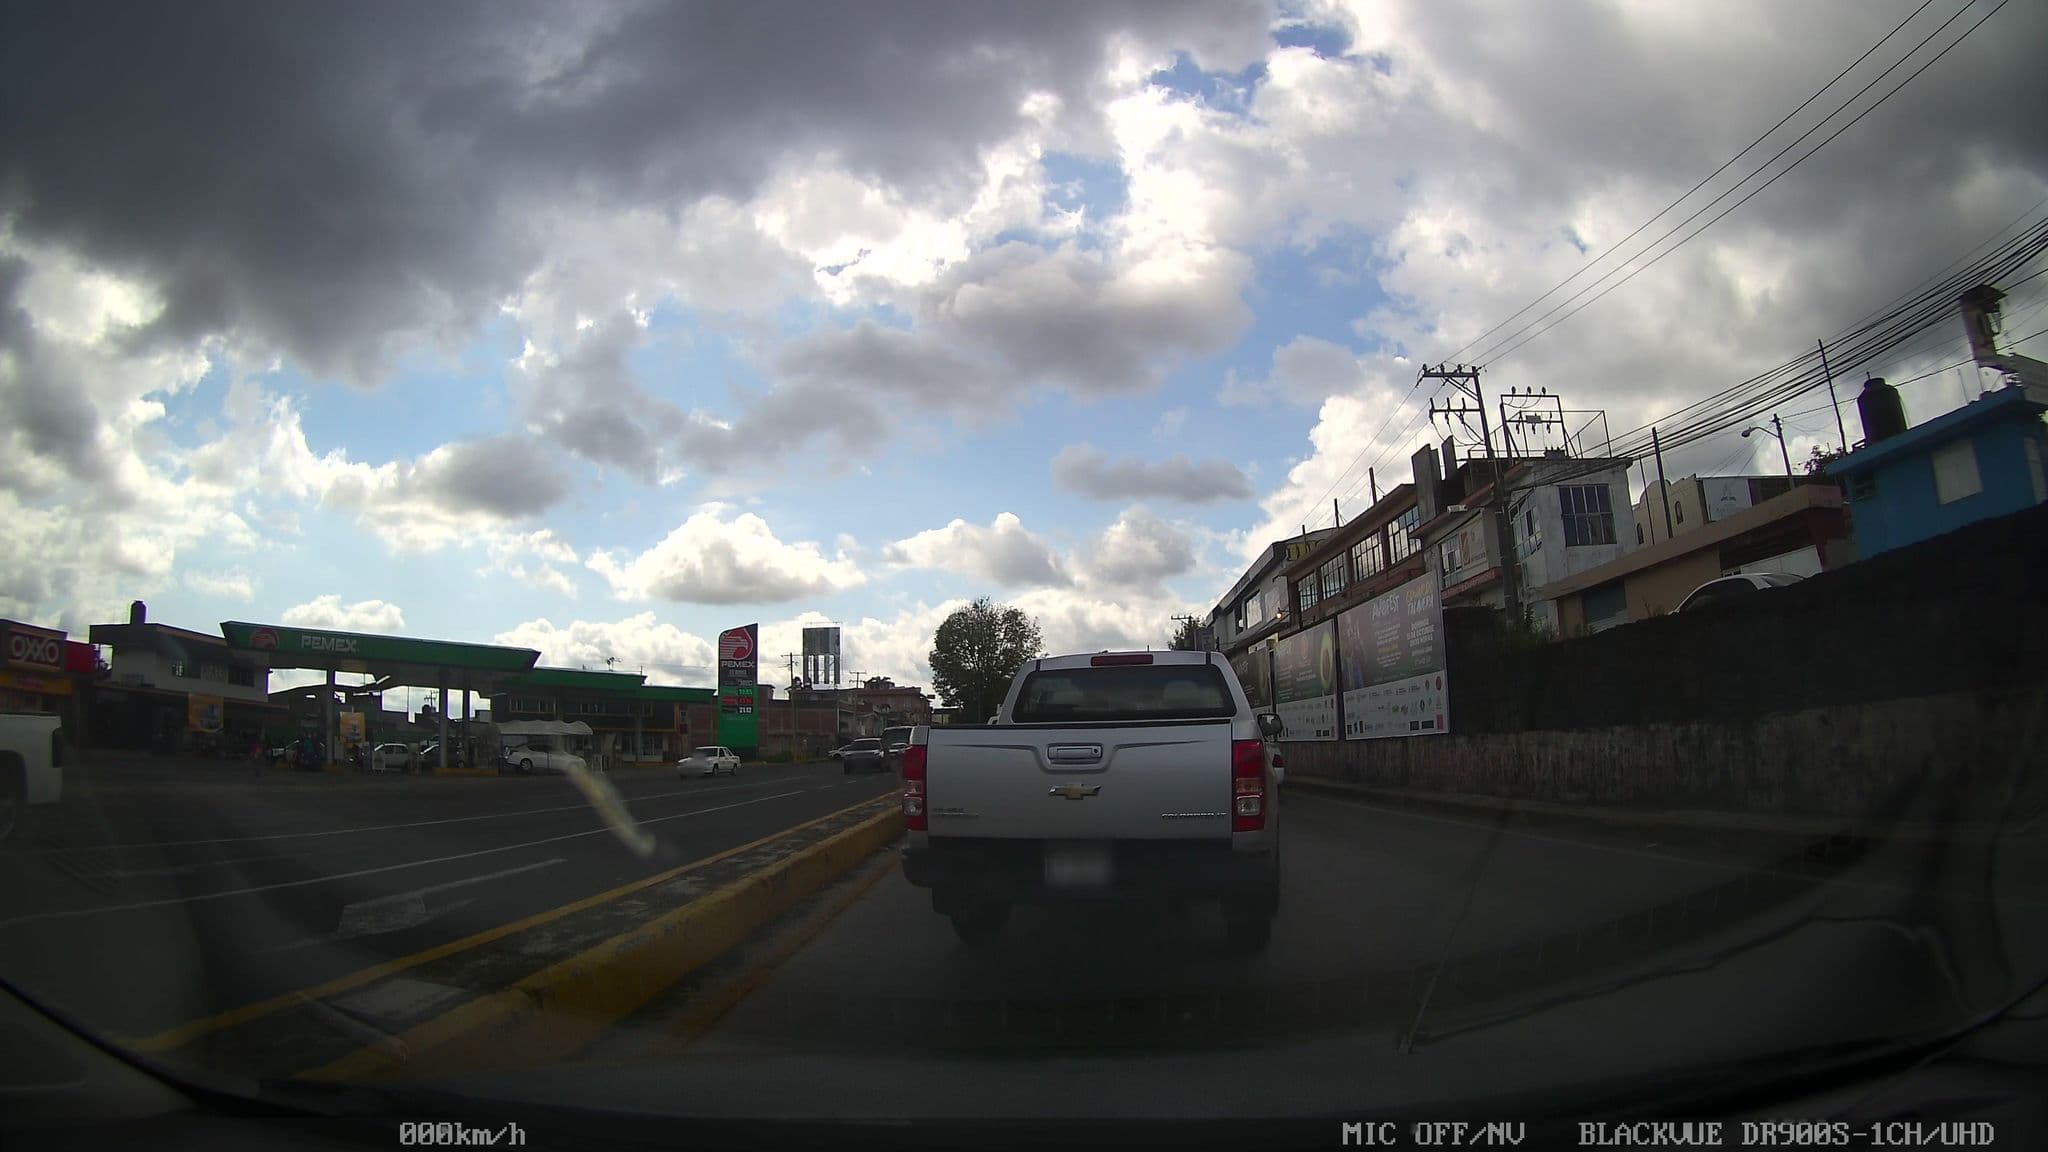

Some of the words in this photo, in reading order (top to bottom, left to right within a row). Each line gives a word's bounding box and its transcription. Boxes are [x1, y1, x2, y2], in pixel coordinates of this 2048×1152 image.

[12, 635, 60, 664] OXXO
[301, 635, 359, 653] PEMEX
[721, 661, 755, 669] PEMEX
